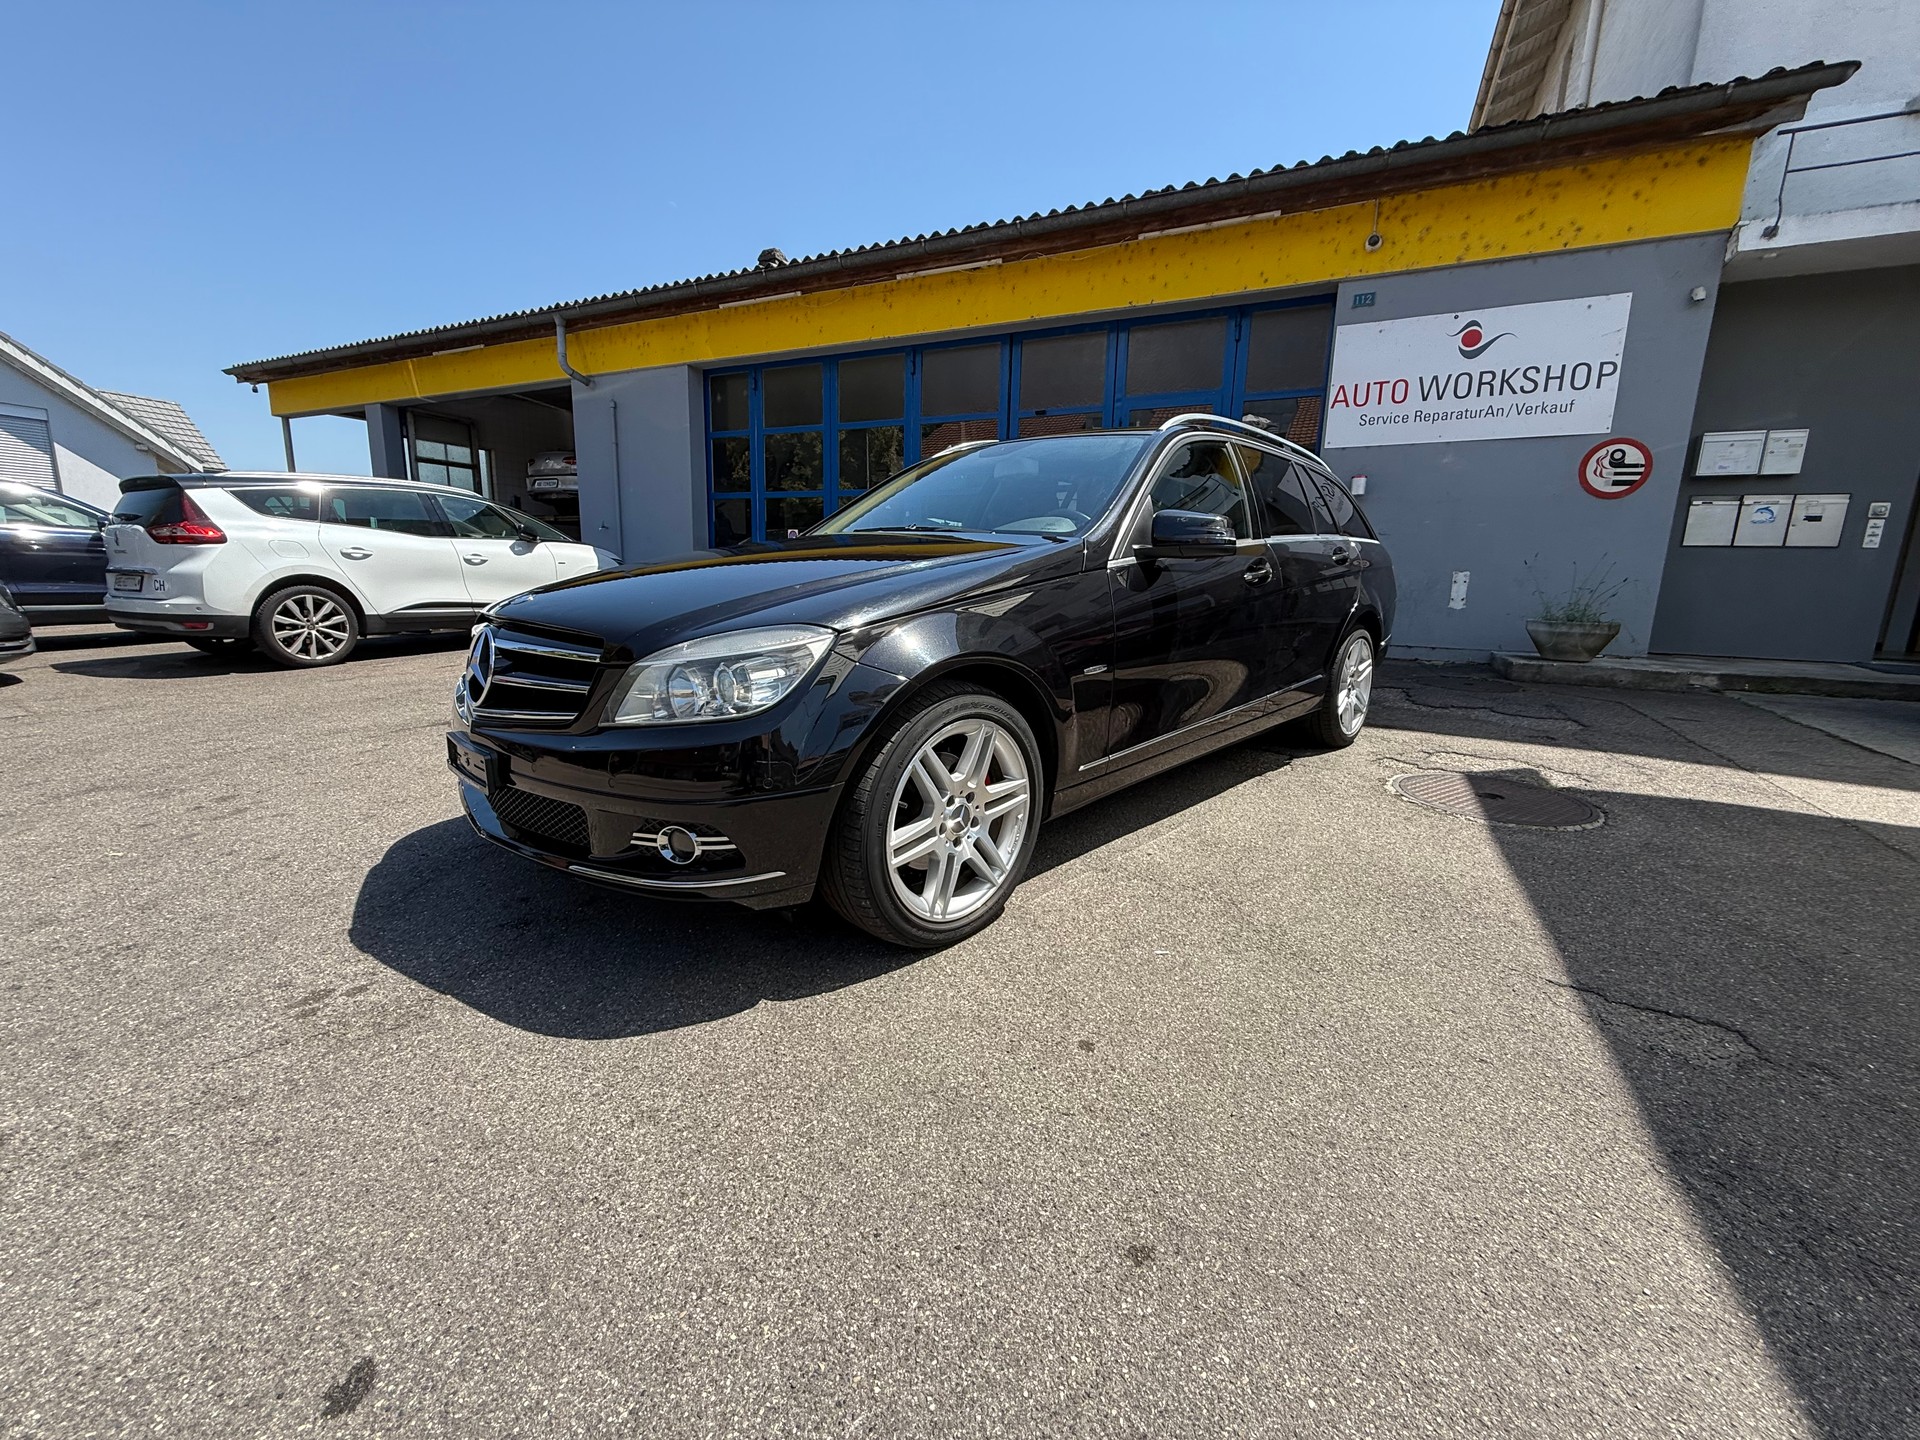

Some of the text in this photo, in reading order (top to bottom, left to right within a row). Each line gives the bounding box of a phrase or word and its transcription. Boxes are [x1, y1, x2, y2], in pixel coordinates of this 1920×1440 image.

[1356, 294, 1372, 305] 112
[1330, 361, 1618, 409] AUTO WORKSHOP
[1359, 412, 1409, 426] Service
[153, 579, 166, 591] CH
